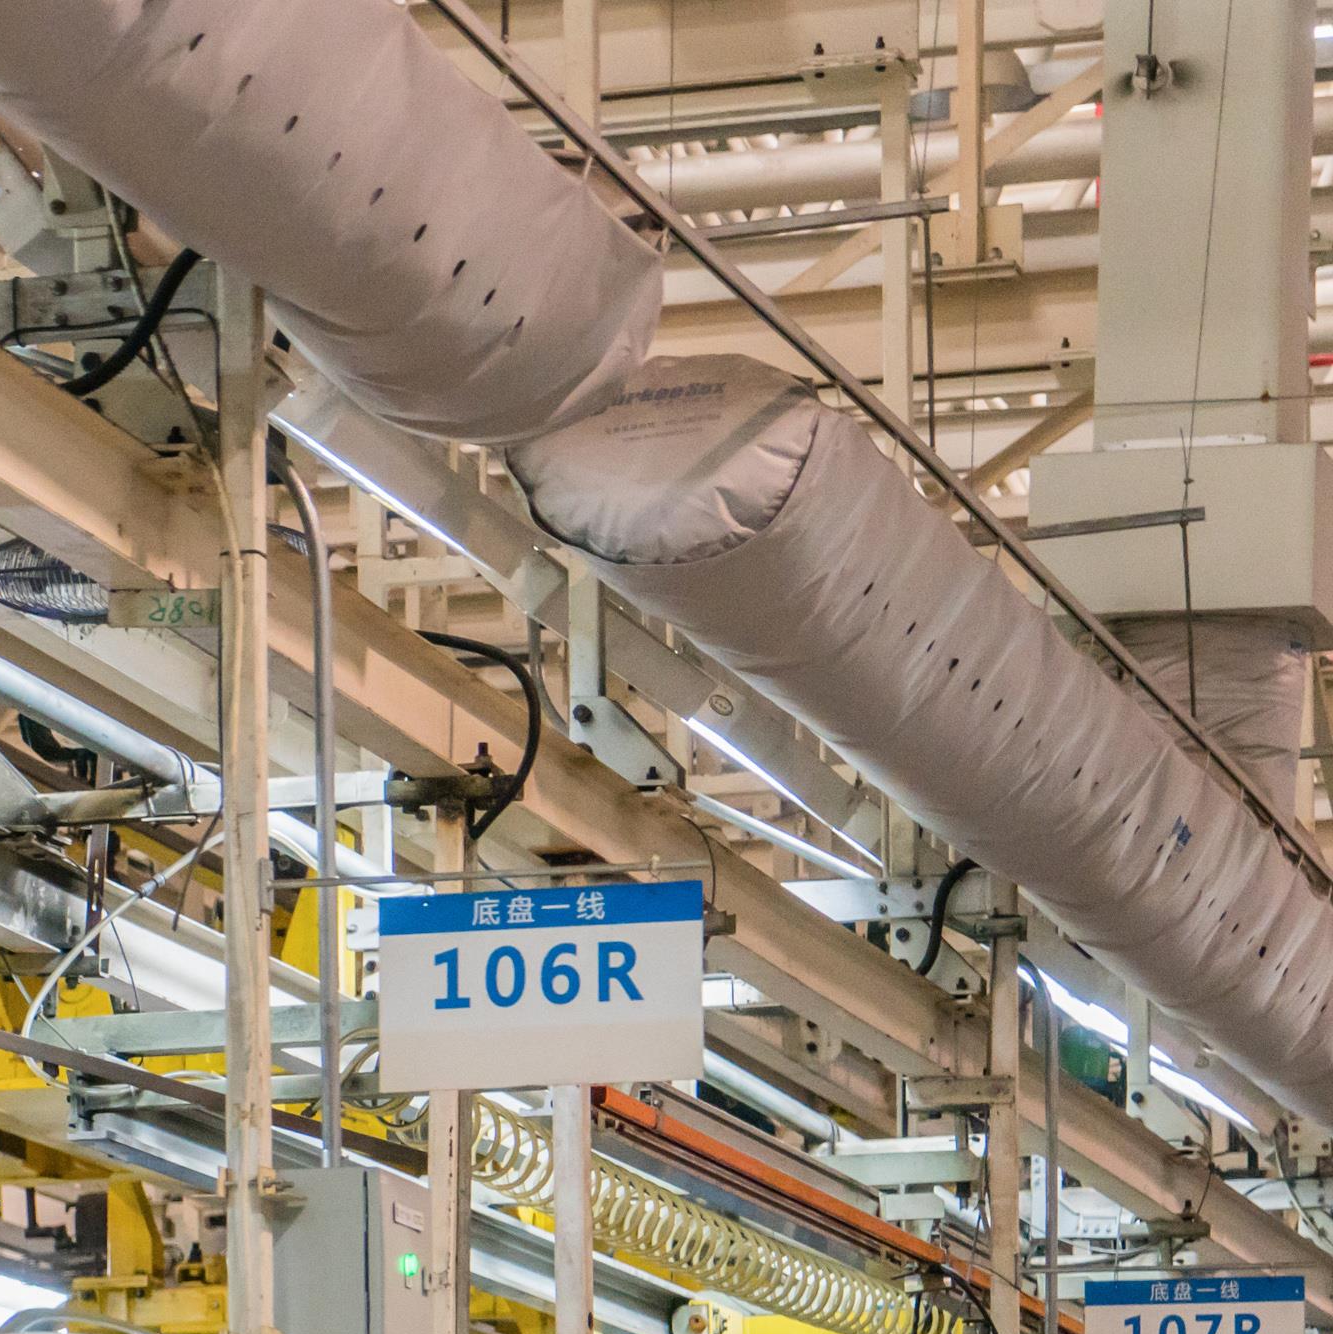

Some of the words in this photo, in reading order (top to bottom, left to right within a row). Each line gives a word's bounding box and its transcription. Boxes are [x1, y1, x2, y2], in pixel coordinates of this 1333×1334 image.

[471, 891, 606, 926] 底盘一线
[434, 941, 644, 1009] 106R
[1149, 1280, 1240, 1302] 底盘一线
